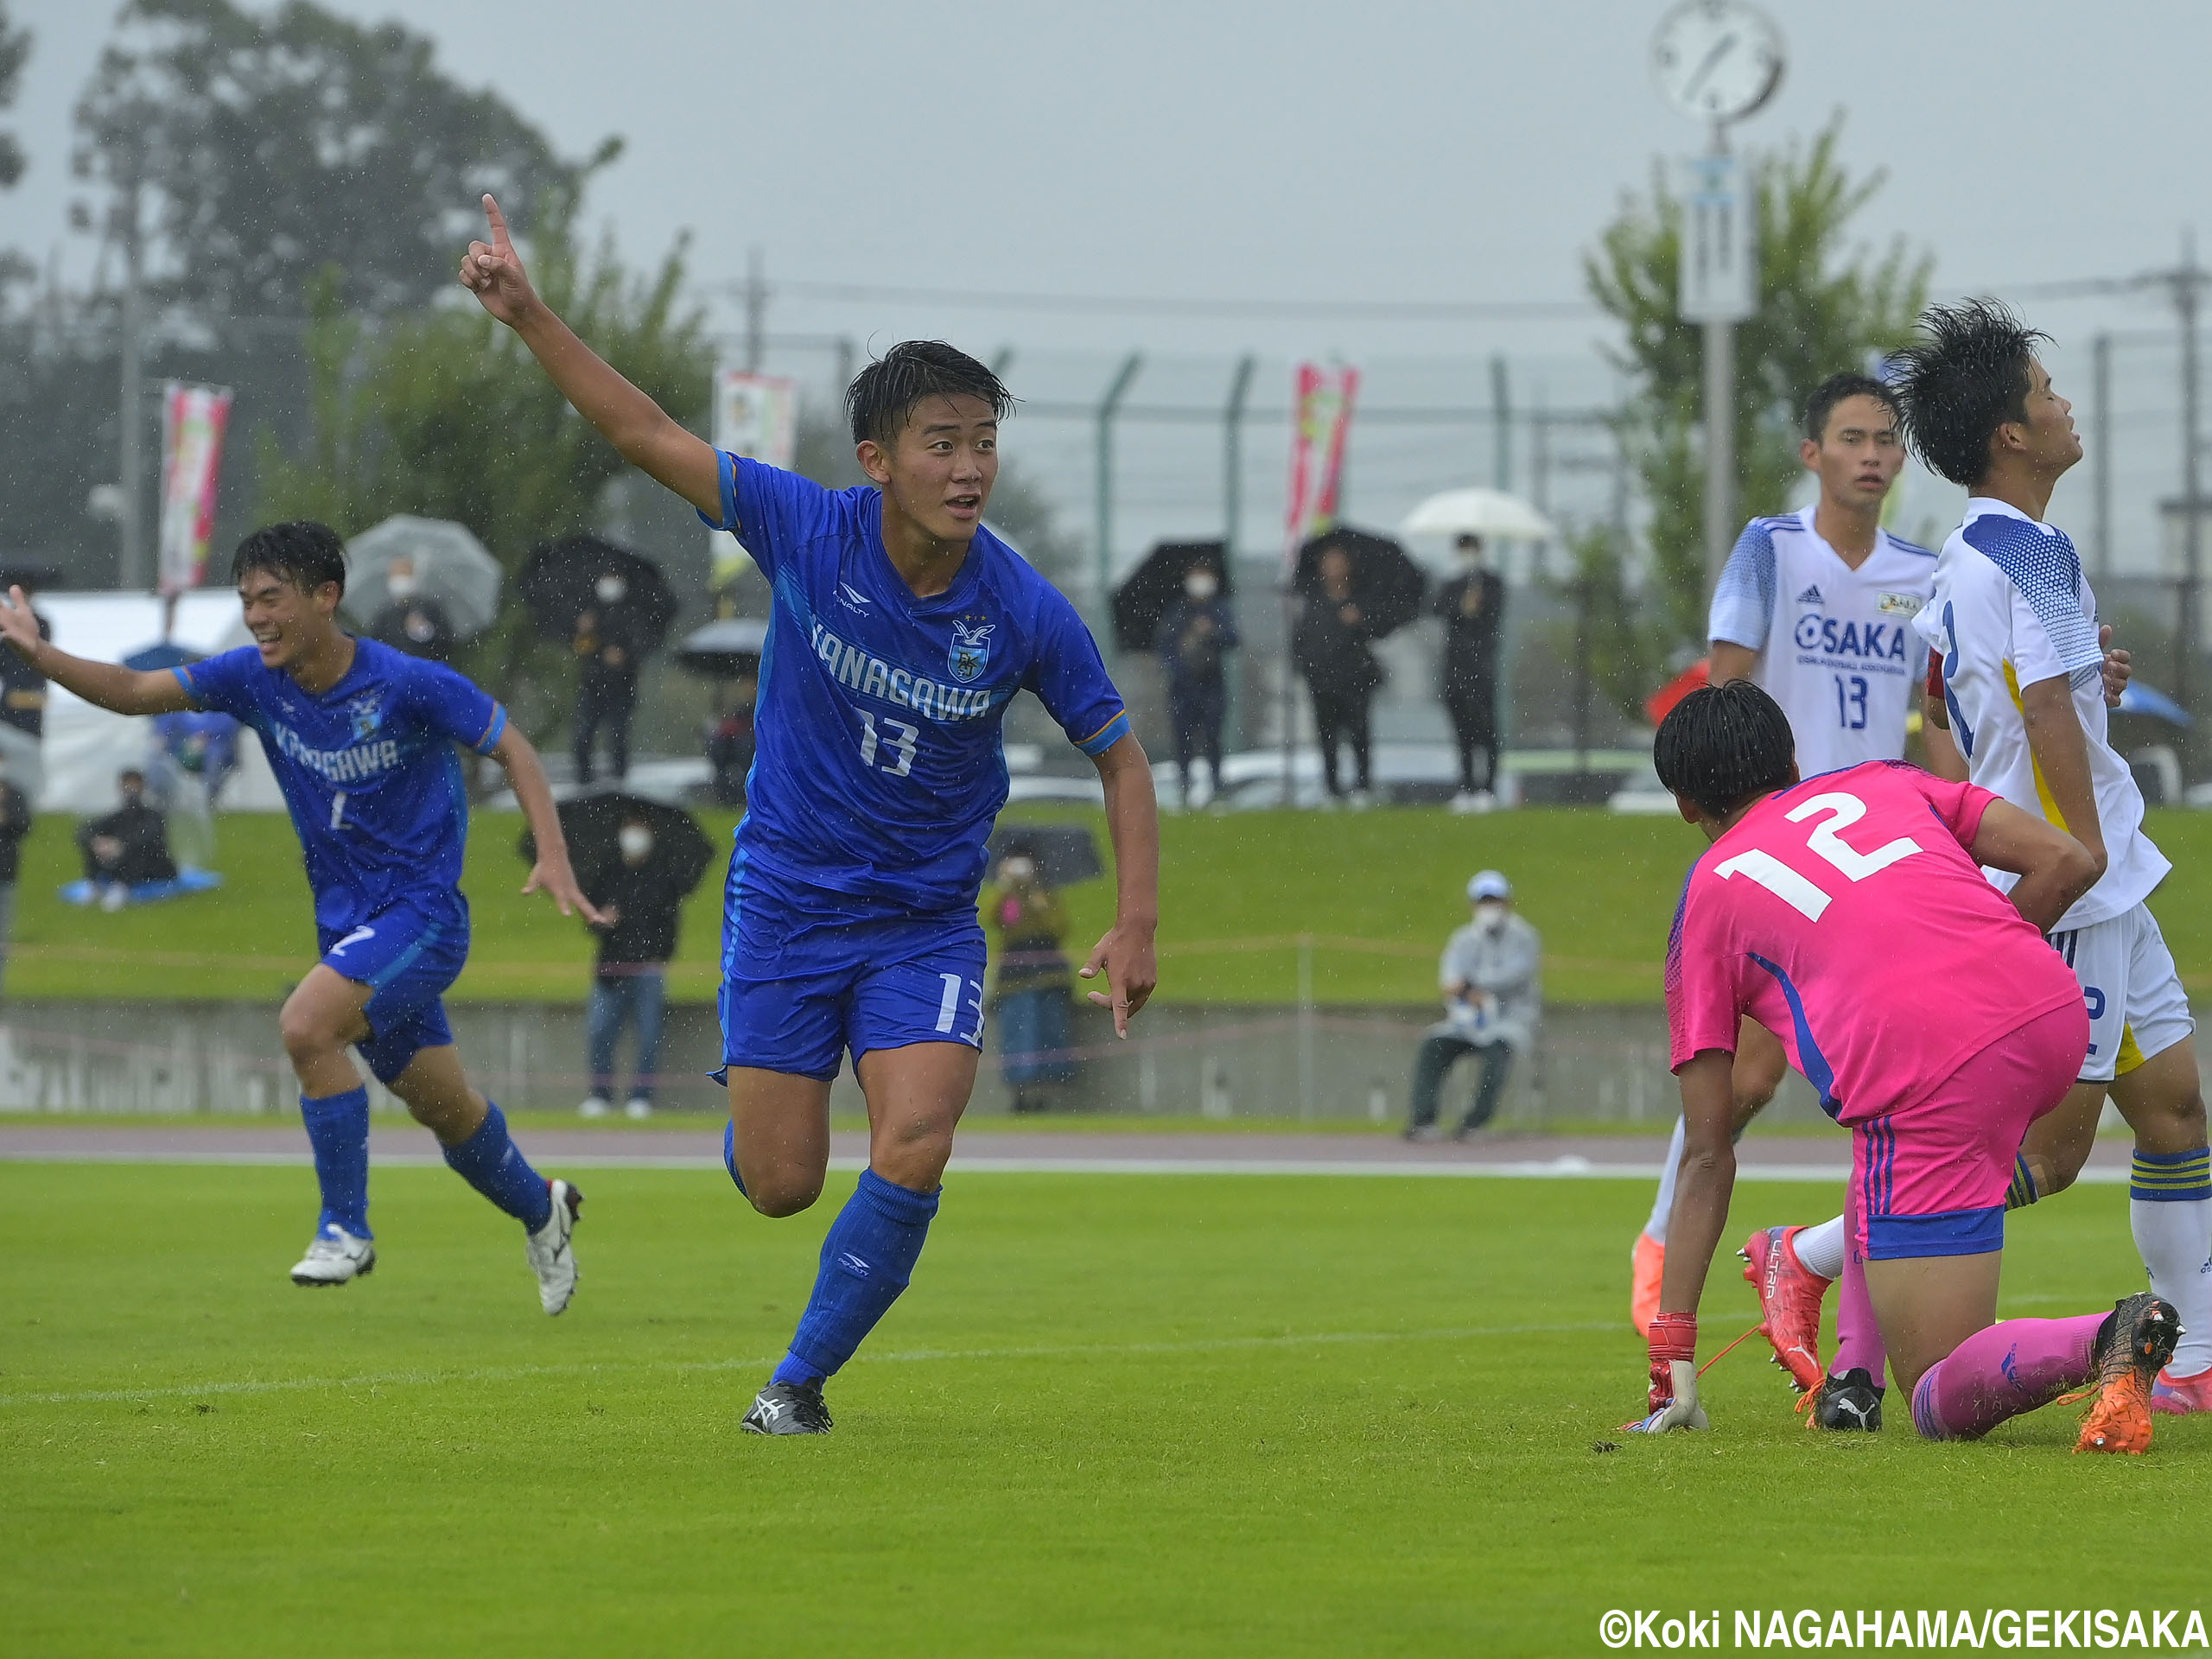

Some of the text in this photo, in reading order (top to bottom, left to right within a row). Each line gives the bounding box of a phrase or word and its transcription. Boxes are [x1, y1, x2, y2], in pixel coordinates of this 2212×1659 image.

[810, 613, 991, 721] KANAGAWA
[1795, 613, 1906, 662] OSAKA
[1834, 674, 1868, 729] 13
[852, 706, 919, 777] 13
[1713, 791, 1924, 923] 12
[934, 973, 985, 1047] 13
[1765, 1239, 1783, 1300] ULTRA
